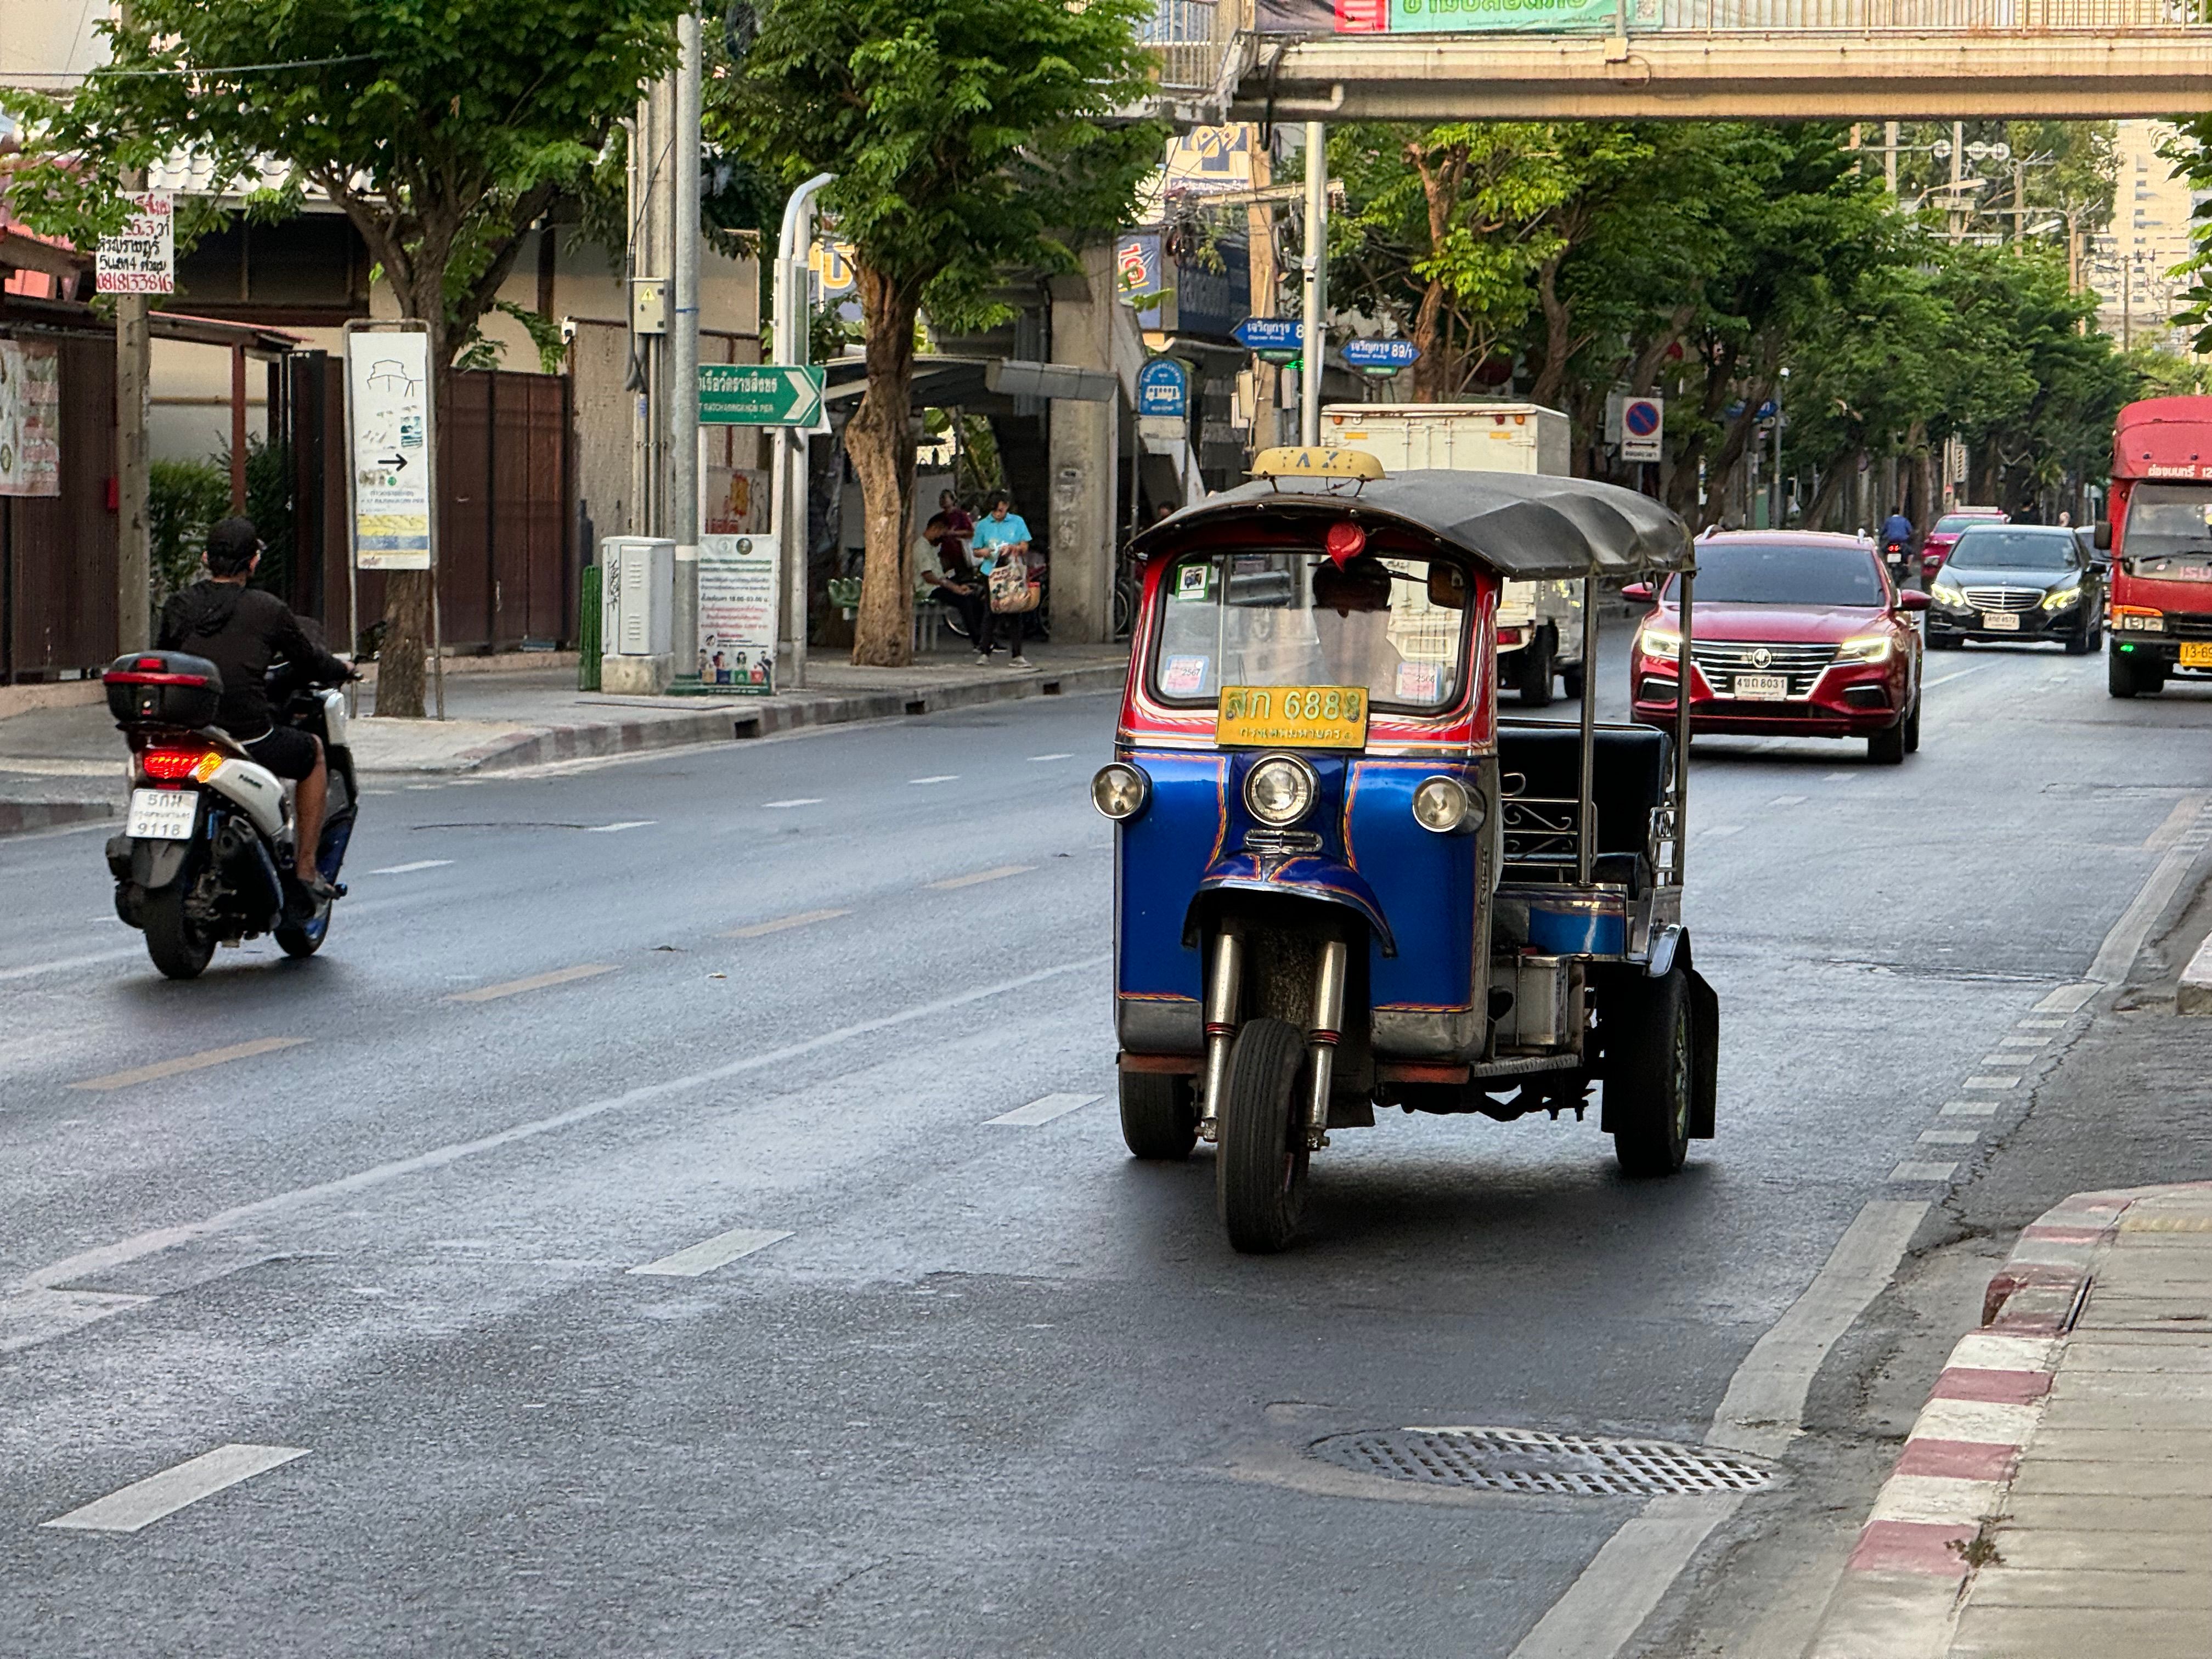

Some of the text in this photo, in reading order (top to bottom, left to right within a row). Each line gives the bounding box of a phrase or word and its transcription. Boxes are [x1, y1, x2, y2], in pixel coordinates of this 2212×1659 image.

[96, 272, 173, 292] 0818133816
[1760, 679, 1784, 689] 8031
[1284, 691, 1361, 722] 6888
[138, 822, 182, 836] 9118
